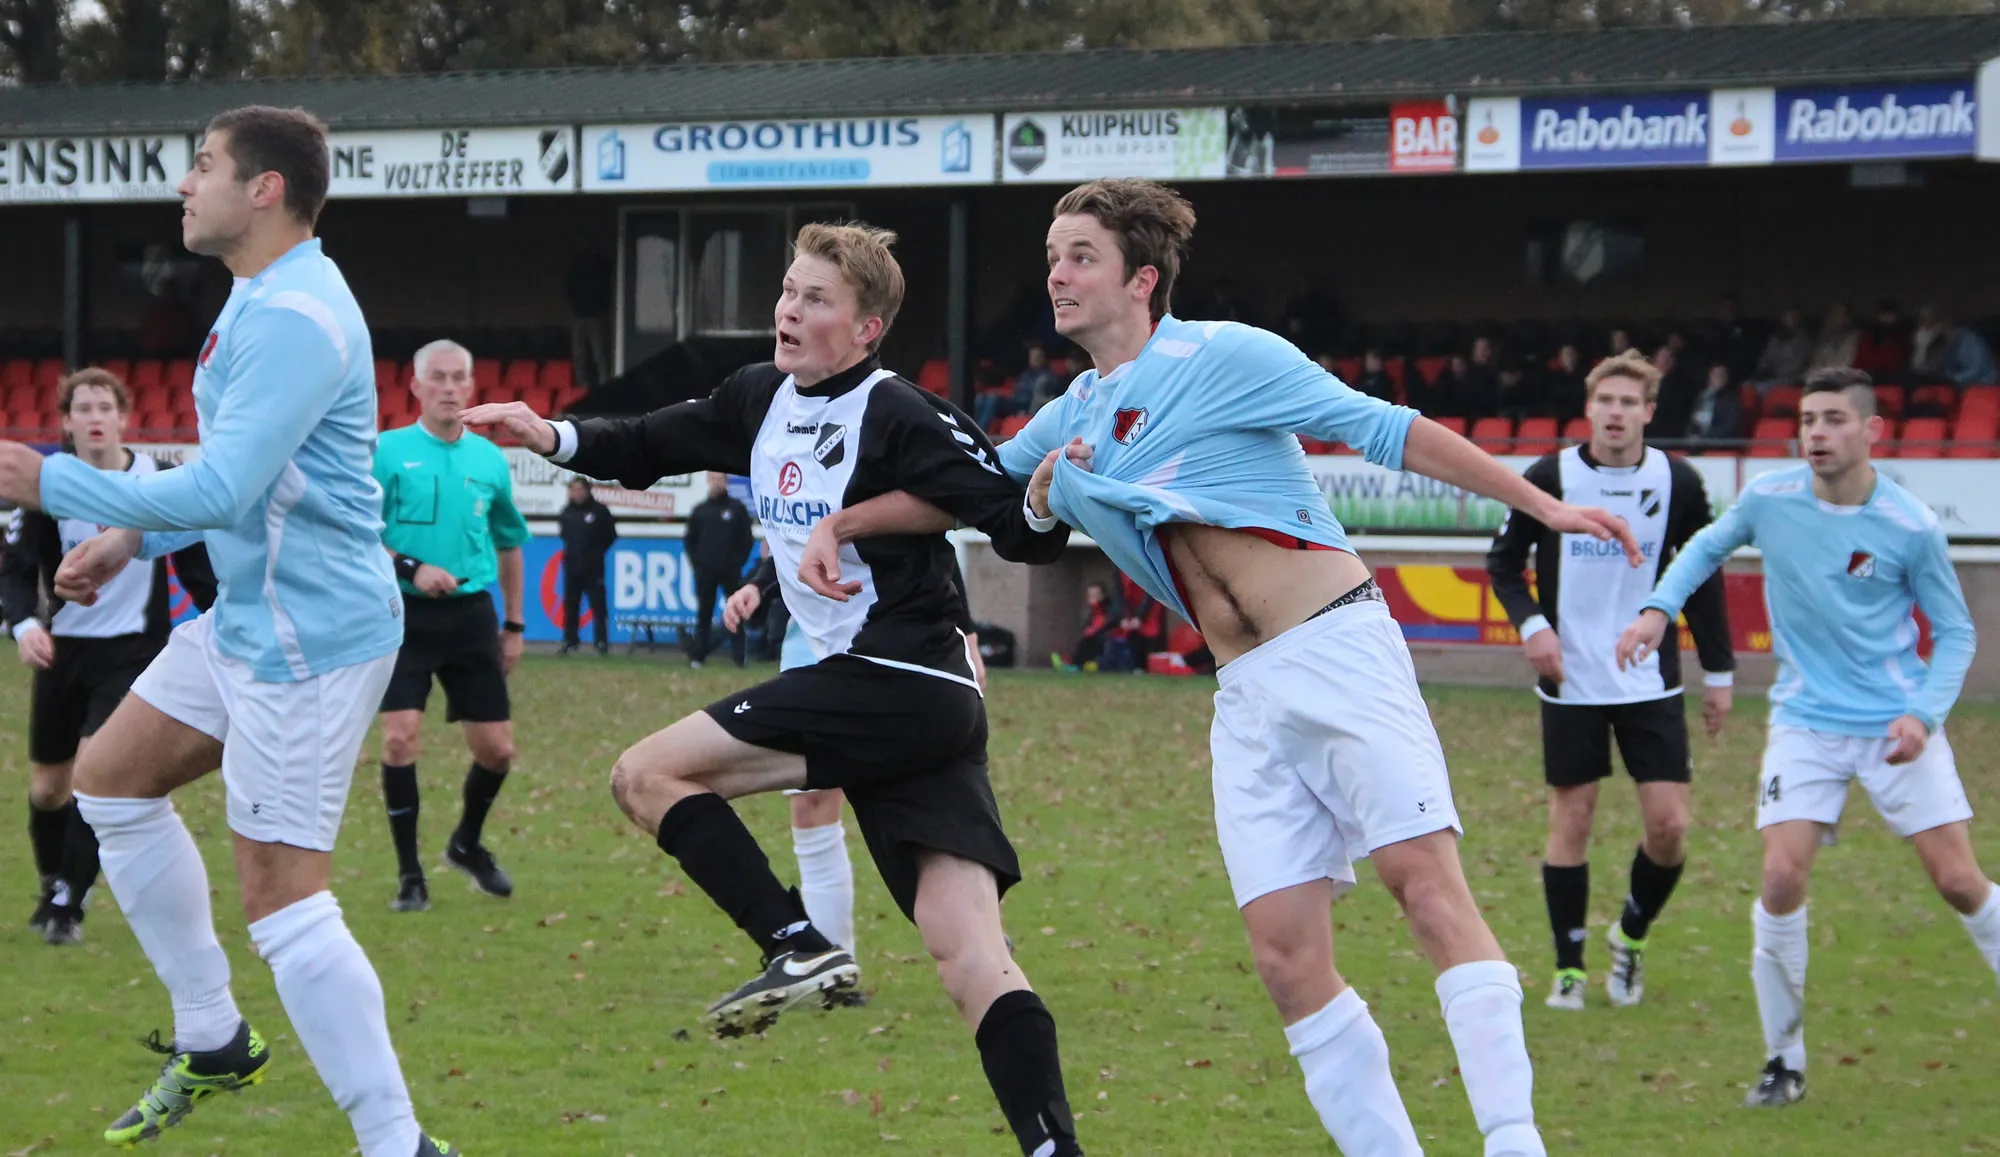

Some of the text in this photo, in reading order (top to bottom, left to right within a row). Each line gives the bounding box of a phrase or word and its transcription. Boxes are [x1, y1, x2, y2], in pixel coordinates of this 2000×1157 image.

[1061, 112, 1180, 138] KUIPHUIS
[1532, 102, 1707, 151] Rabobank
[1786, 91, 1975, 144] Rabobank
[440, 130, 470, 158] DE
[654, 118, 920, 152] GROOTHUIS
[1394, 116, 1457, 154] BAR
[384, 157, 523, 190] VOLTREFFER
